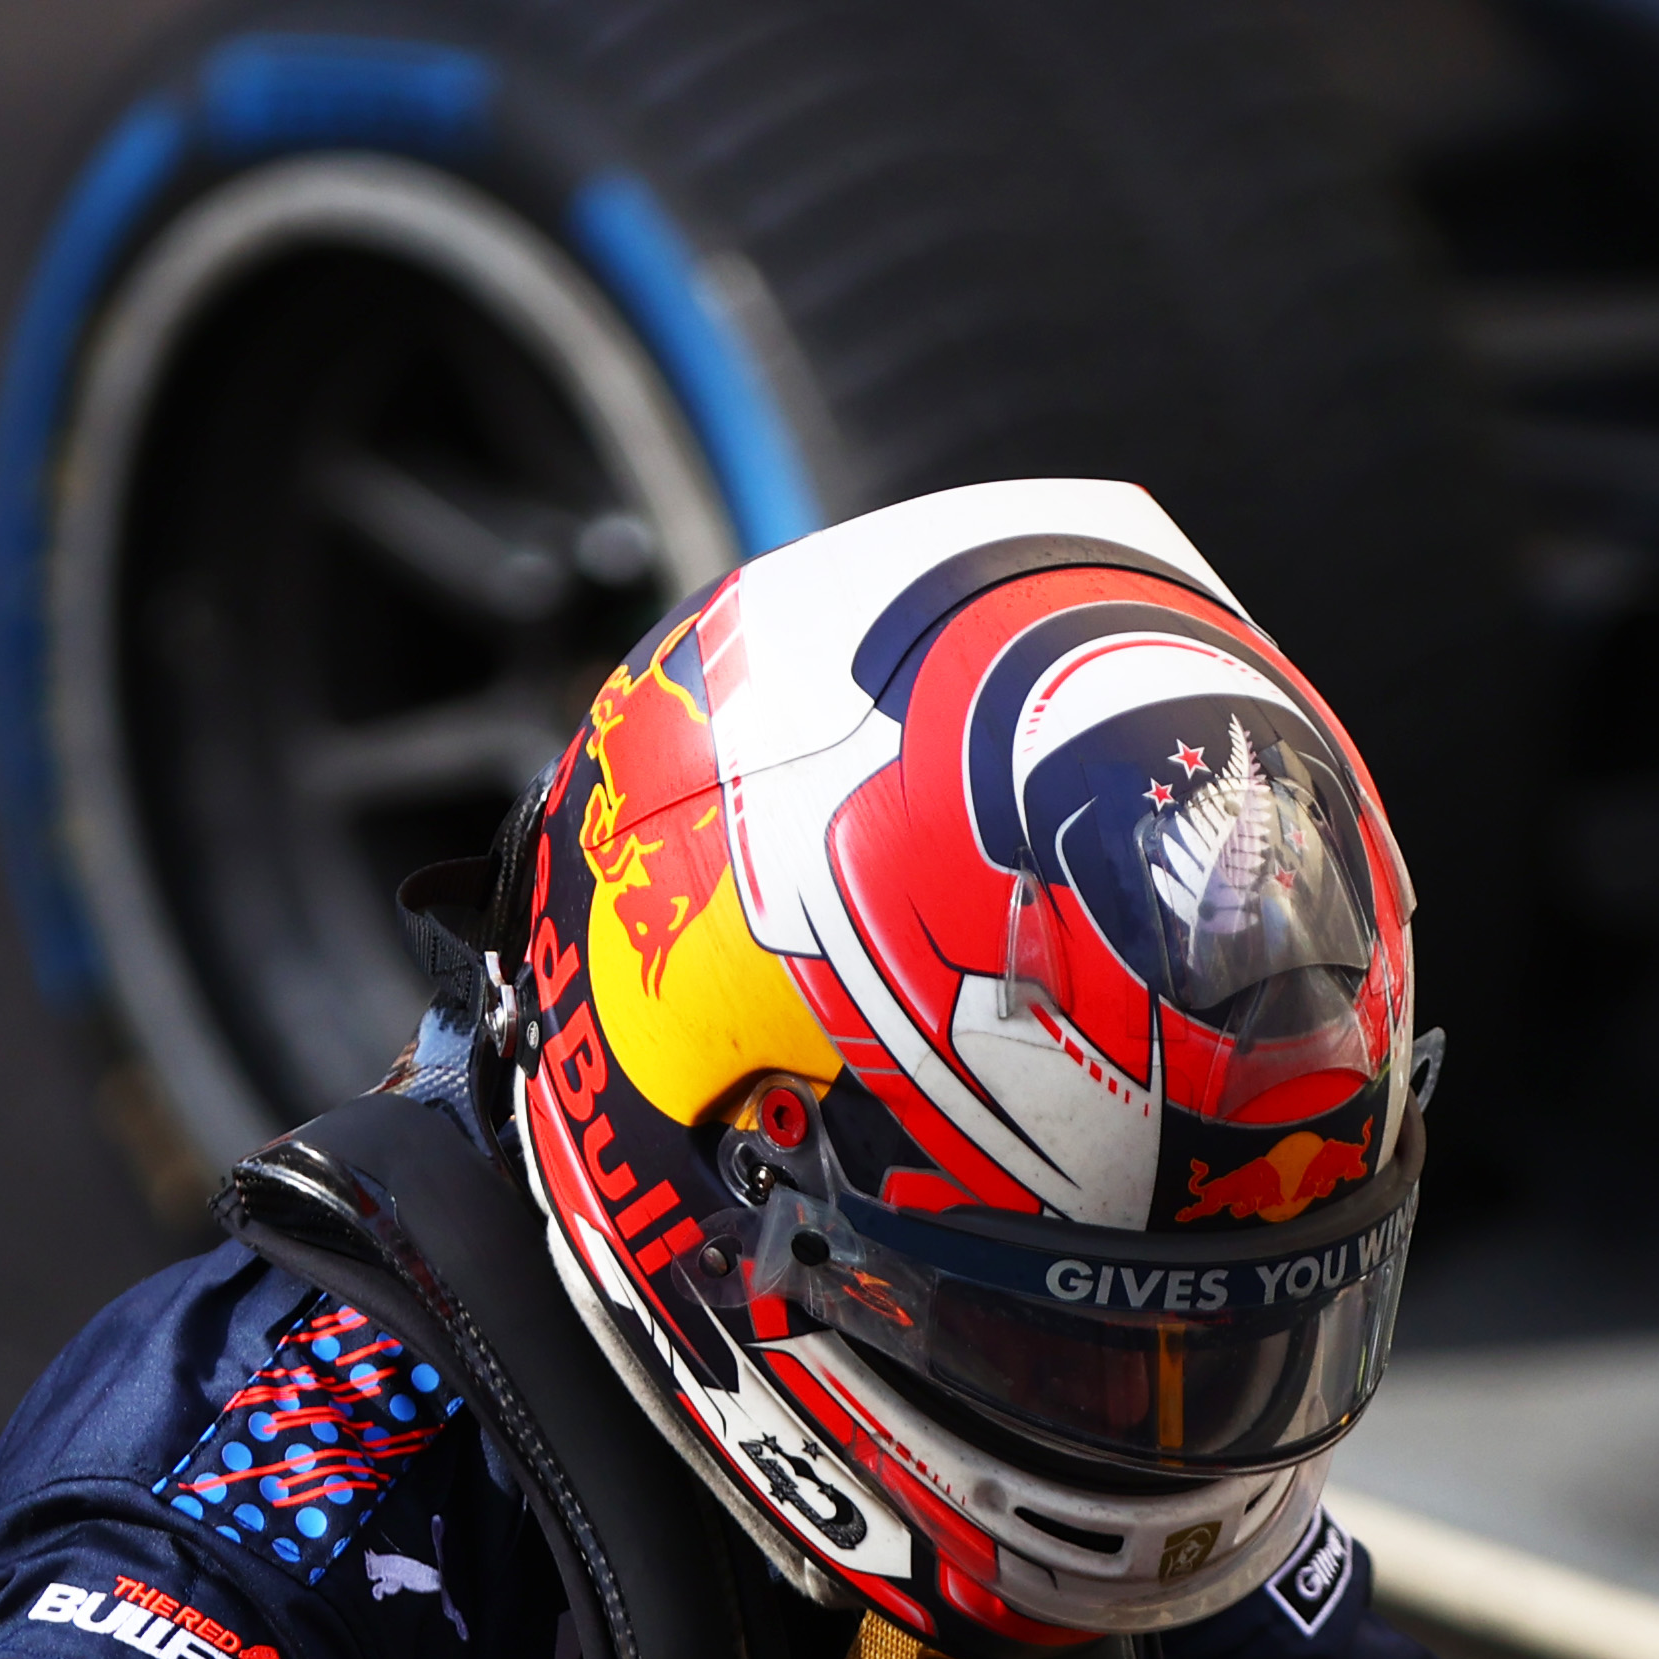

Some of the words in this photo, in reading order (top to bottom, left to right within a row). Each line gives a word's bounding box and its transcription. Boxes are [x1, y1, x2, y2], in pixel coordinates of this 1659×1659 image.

[542, 1000, 706, 1277] Bull
[1045, 1258, 1229, 1311] GIVES
[1255, 1245, 1348, 1305] YOU
[1358, 1196, 1412, 1275] WIN
[113, 1574, 180, 1619] THE
[172, 1604, 243, 1654] RED
